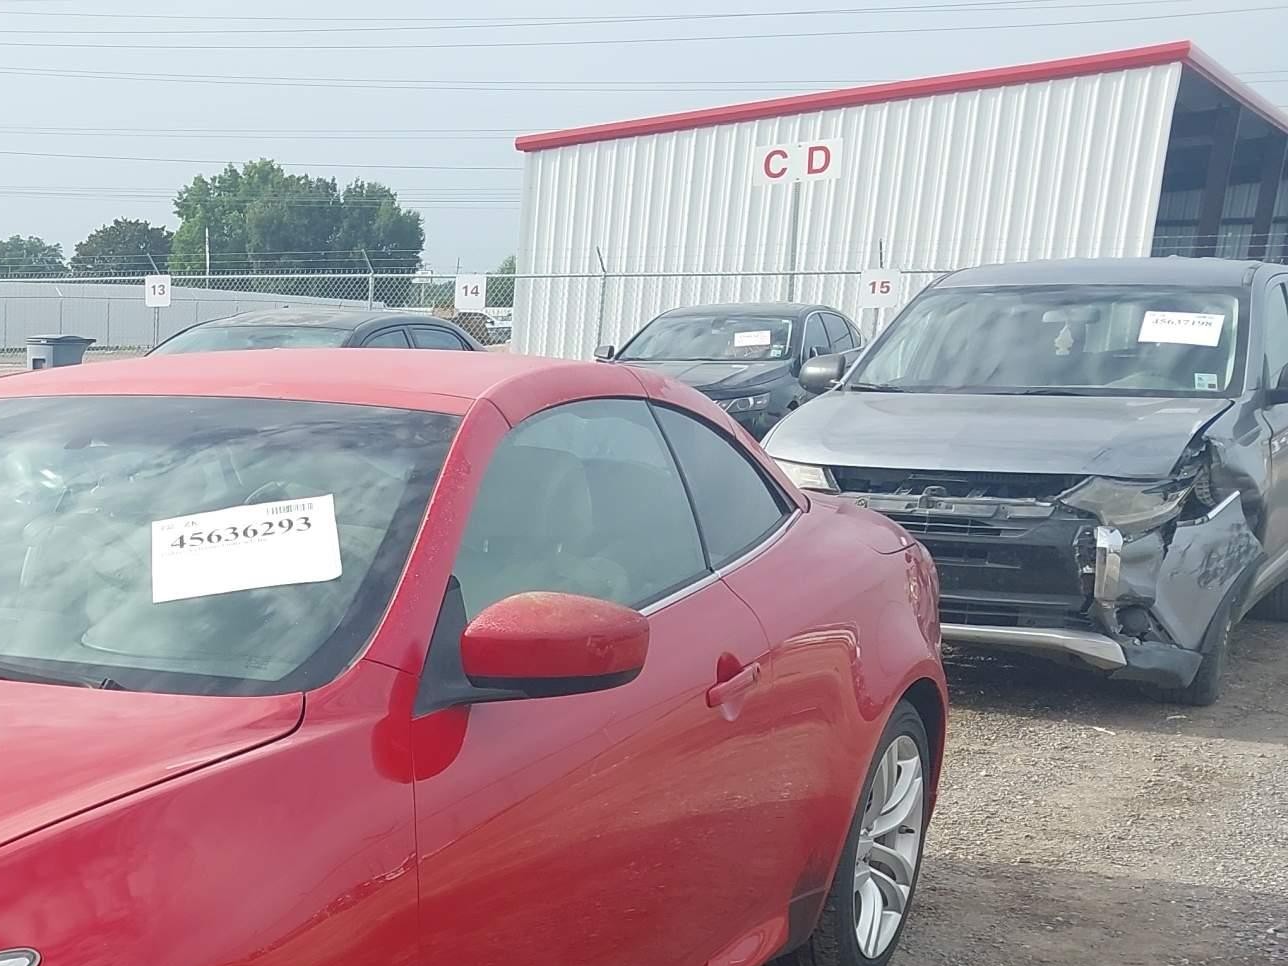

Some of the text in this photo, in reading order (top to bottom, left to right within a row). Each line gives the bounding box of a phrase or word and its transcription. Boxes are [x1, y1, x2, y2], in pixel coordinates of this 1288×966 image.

[764, 145, 831, 178] C D
[151, 284, 166, 296] 13
[461, 284, 481, 297] 14
[868, 280, 891, 294] 15
[170, 516, 313, 549] 45636293
